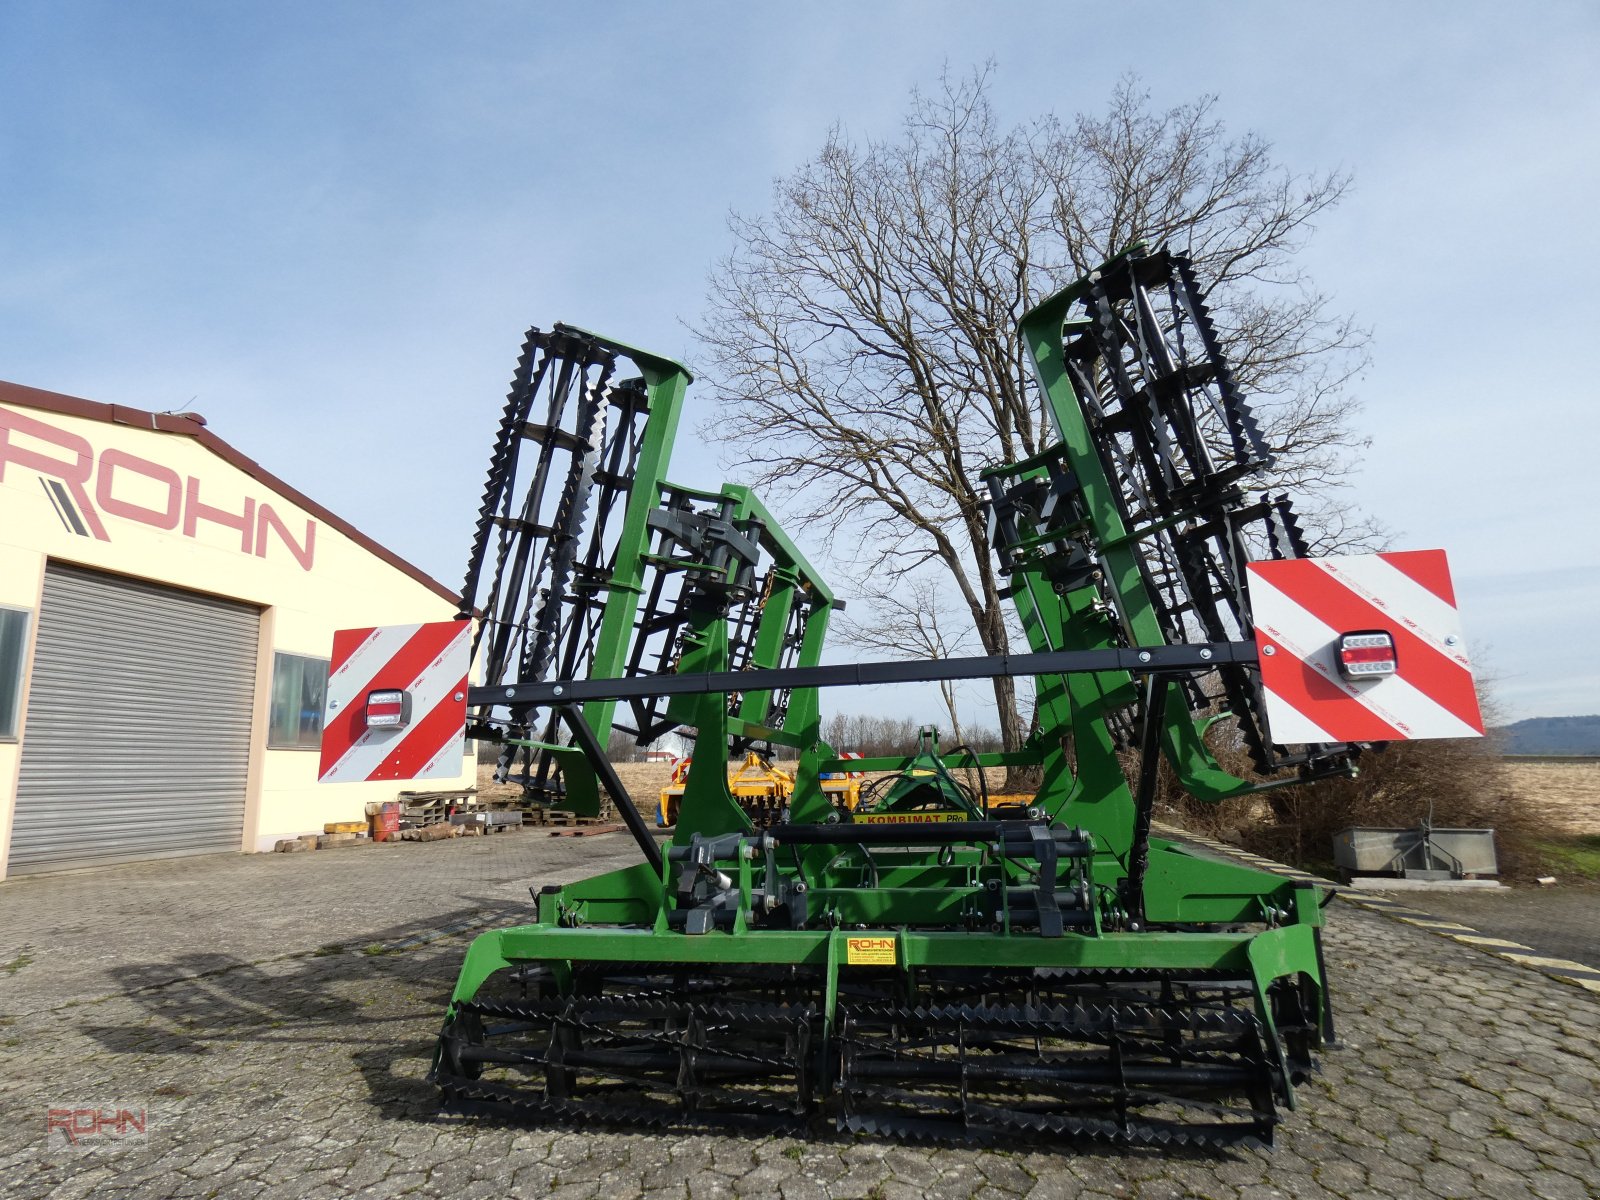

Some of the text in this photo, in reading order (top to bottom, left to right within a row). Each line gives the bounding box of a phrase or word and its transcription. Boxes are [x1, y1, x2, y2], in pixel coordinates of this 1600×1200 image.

[0, 407, 316, 572] ROHN
[867, 815, 941, 824] KOMBIMAT
[849, 940, 893, 950] ROHN
